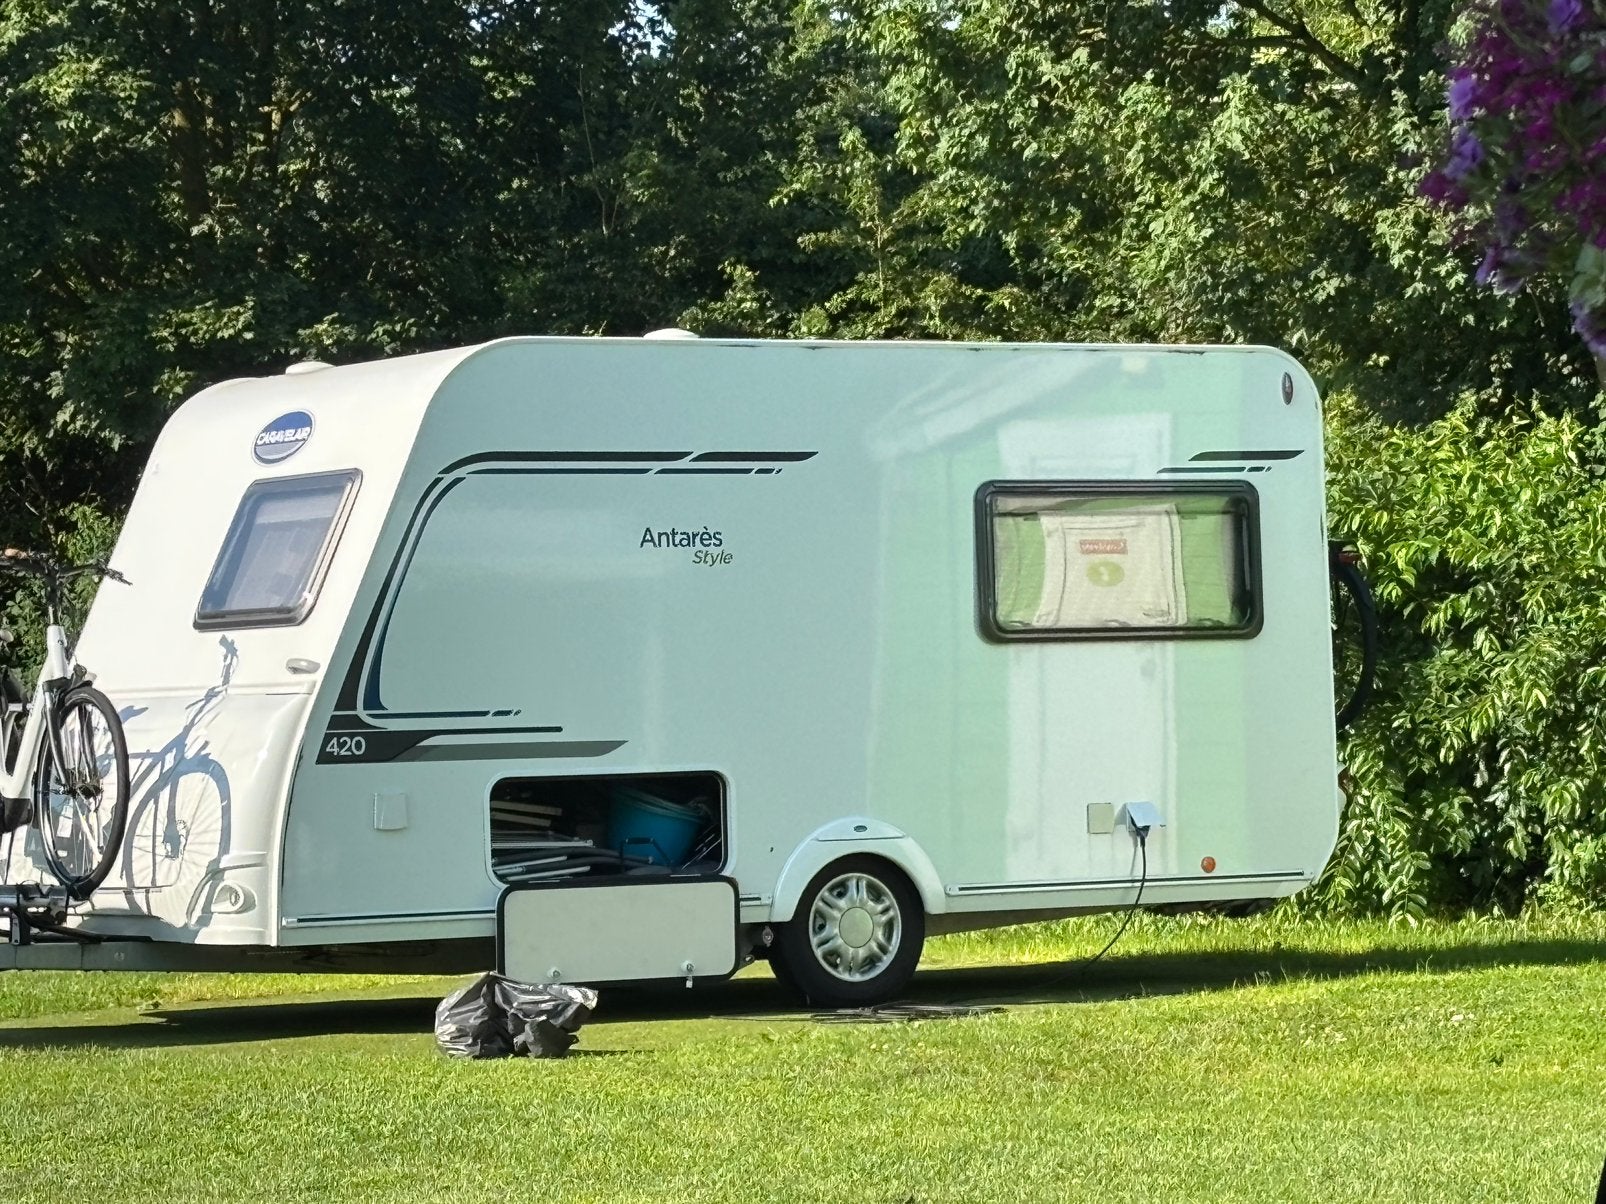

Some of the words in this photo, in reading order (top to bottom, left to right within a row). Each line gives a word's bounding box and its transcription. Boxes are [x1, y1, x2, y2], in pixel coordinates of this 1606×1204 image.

[640, 526, 723, 548] Antarès
[692, 549, 733, 567] Style
[325, 736, 366, 756] 420
